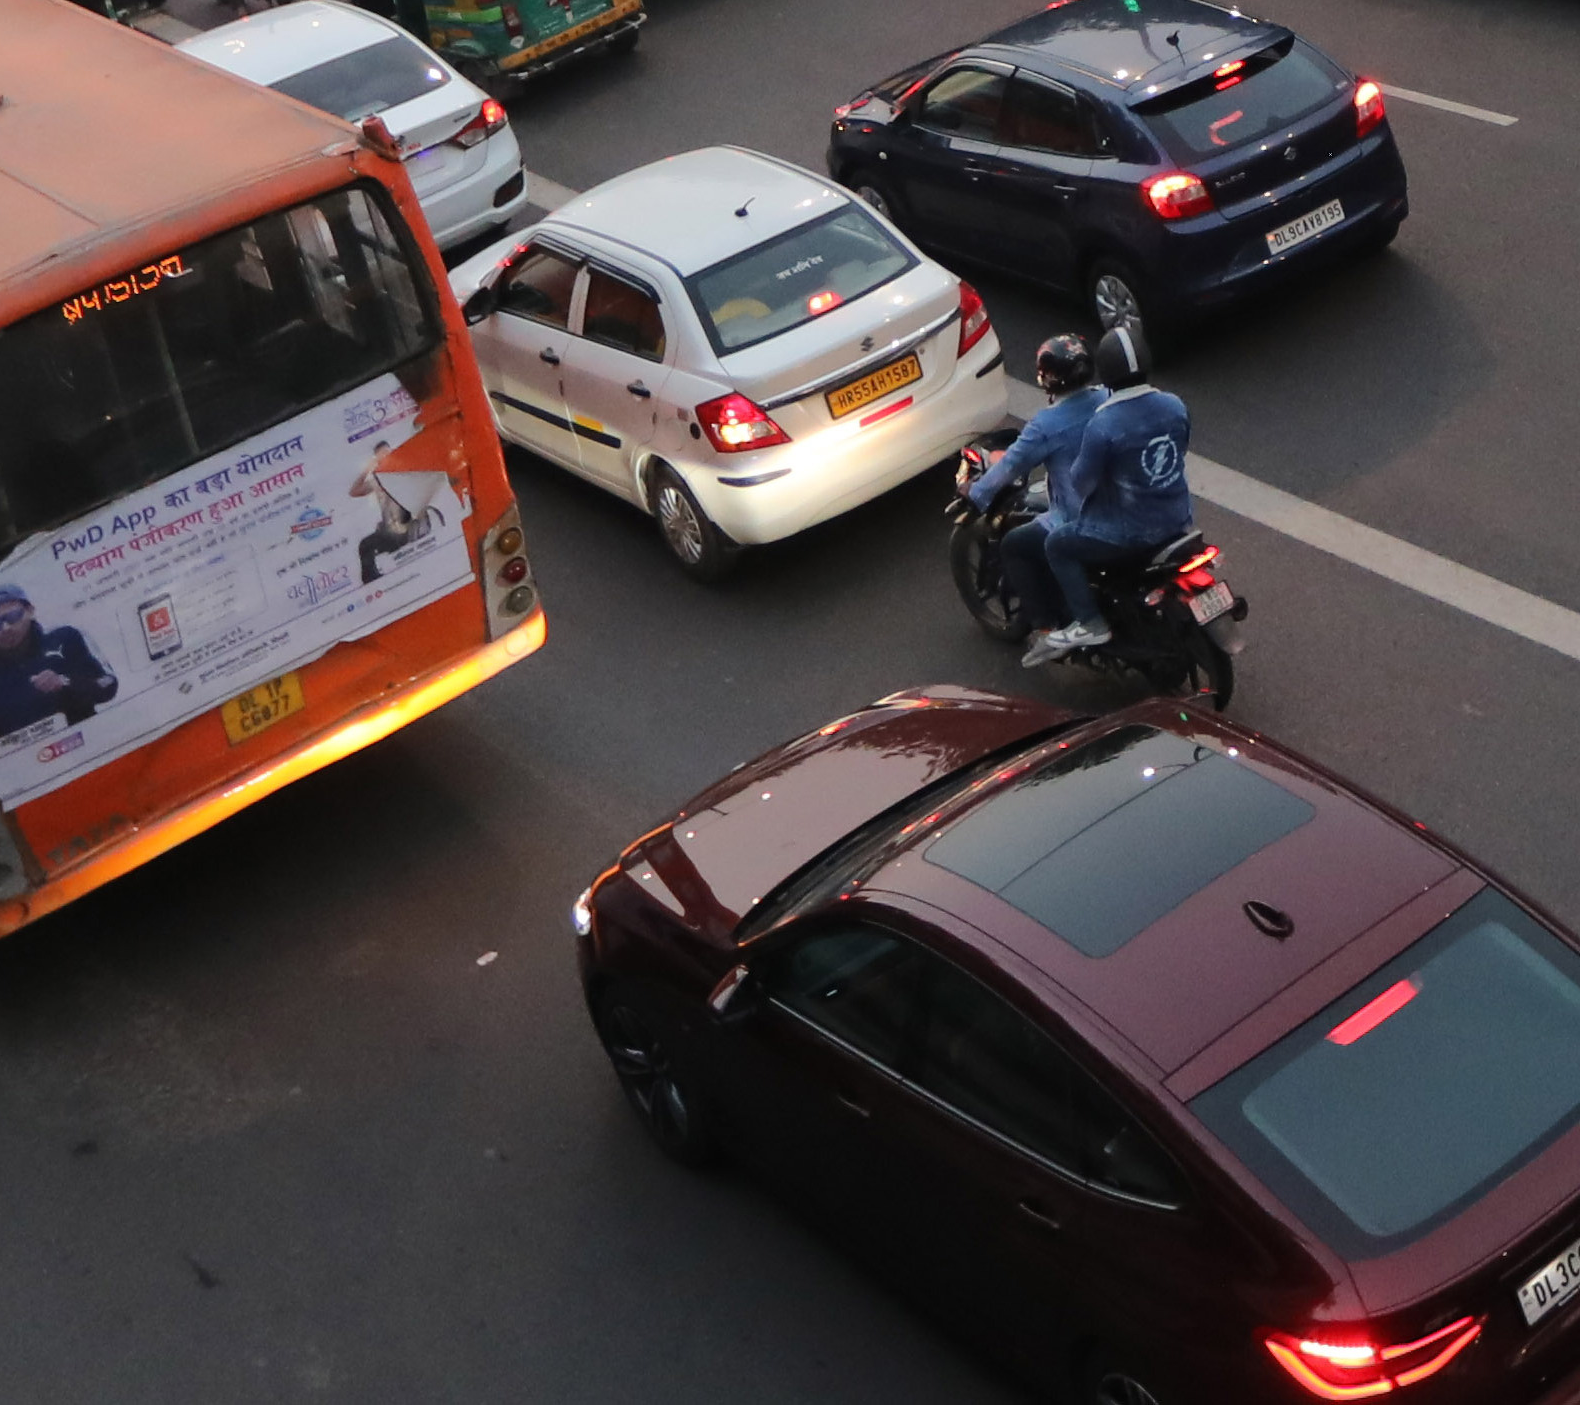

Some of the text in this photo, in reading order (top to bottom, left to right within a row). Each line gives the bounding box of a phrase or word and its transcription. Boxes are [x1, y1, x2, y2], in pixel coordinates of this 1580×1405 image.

[52, 525, 104, 560] PwD
[111, 505, 157, 535] App
[164, 486, 191, 509] का
[235, 434, 305, 476] योगदान
[64, 543, 125, 582] दिव्यांग
[127, 509, 205, 553] पंजीकरण
[207, 490, 244, 524] हुआ
[248, 462, 306, 500] आसान
